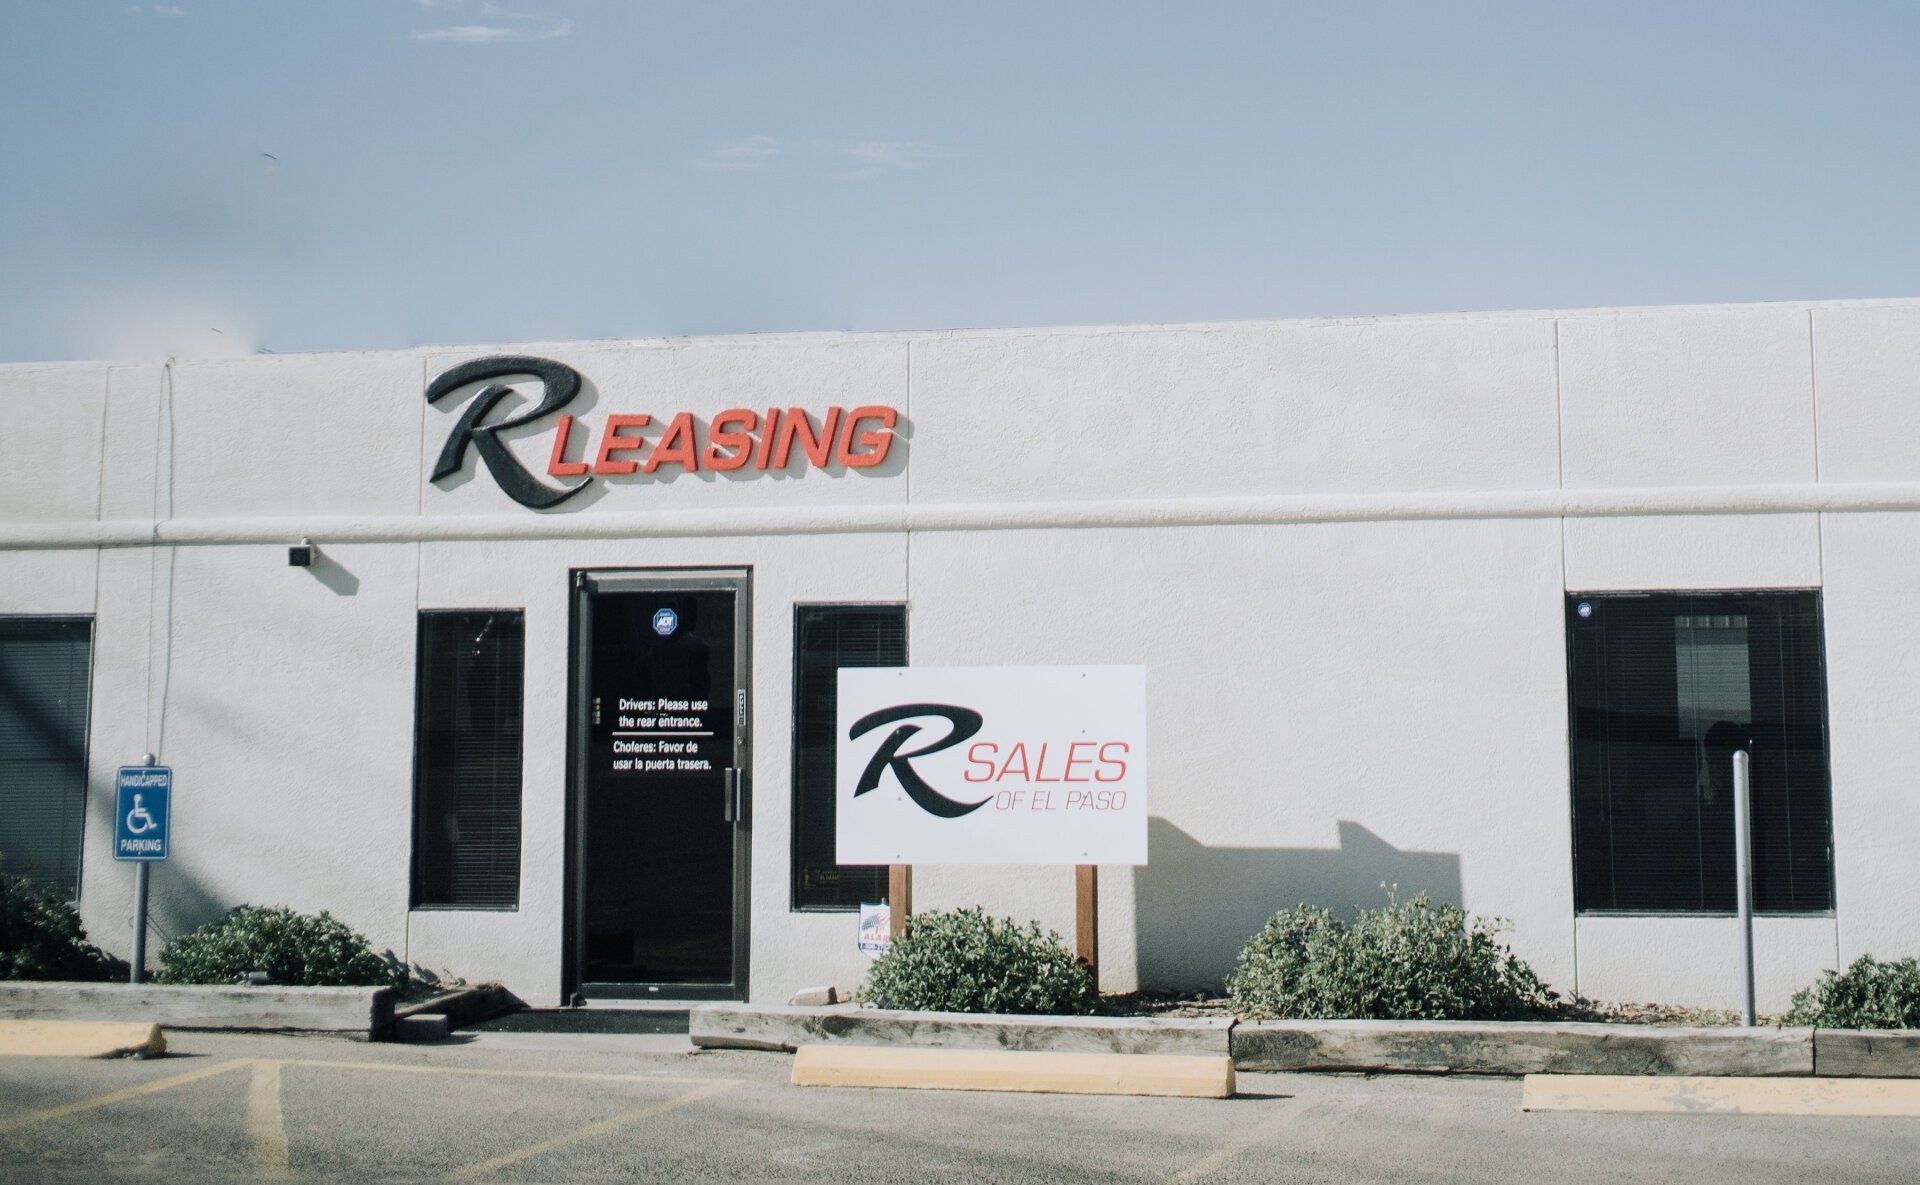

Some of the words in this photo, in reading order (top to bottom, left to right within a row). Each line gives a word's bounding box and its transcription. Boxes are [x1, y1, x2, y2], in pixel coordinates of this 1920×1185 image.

[426, 355, 594, 511] R
[547, 406, 898, 476] LEASING
[657, 616, 673, 627] ADT
[619, 698, 656, 711] Drivers:
[658, 698, 689, 711] Please
[691, 700, 708, 711] use
[619, 715, 635, 727] the
[636, 717, 657, 728] rear
[658, 716, 703, 728] entrance.
[613, 740, 656, 753] Choferes:
[658, 740, 685, 753] Favor
[686, 740, 698, 753] de
[613, 759, 633, 770] usar
[634, 757, 643, 770] la
[645, 758, 675, 772] puerta
[677, 758, 712, 770] trasera.
[849, 702, 995, 819] R
[963, 741, 1131, 783] SALES
[120, 774, 168, 787] HANDICAPPED
[996, 790, 1026, 810] OF
[1031, 790, 1056, 810] EL
[1066, 790, 1128, 810] PASO
[120, 839, 161, 851] PARKING
[864, 933, 890, 941] ALAR
